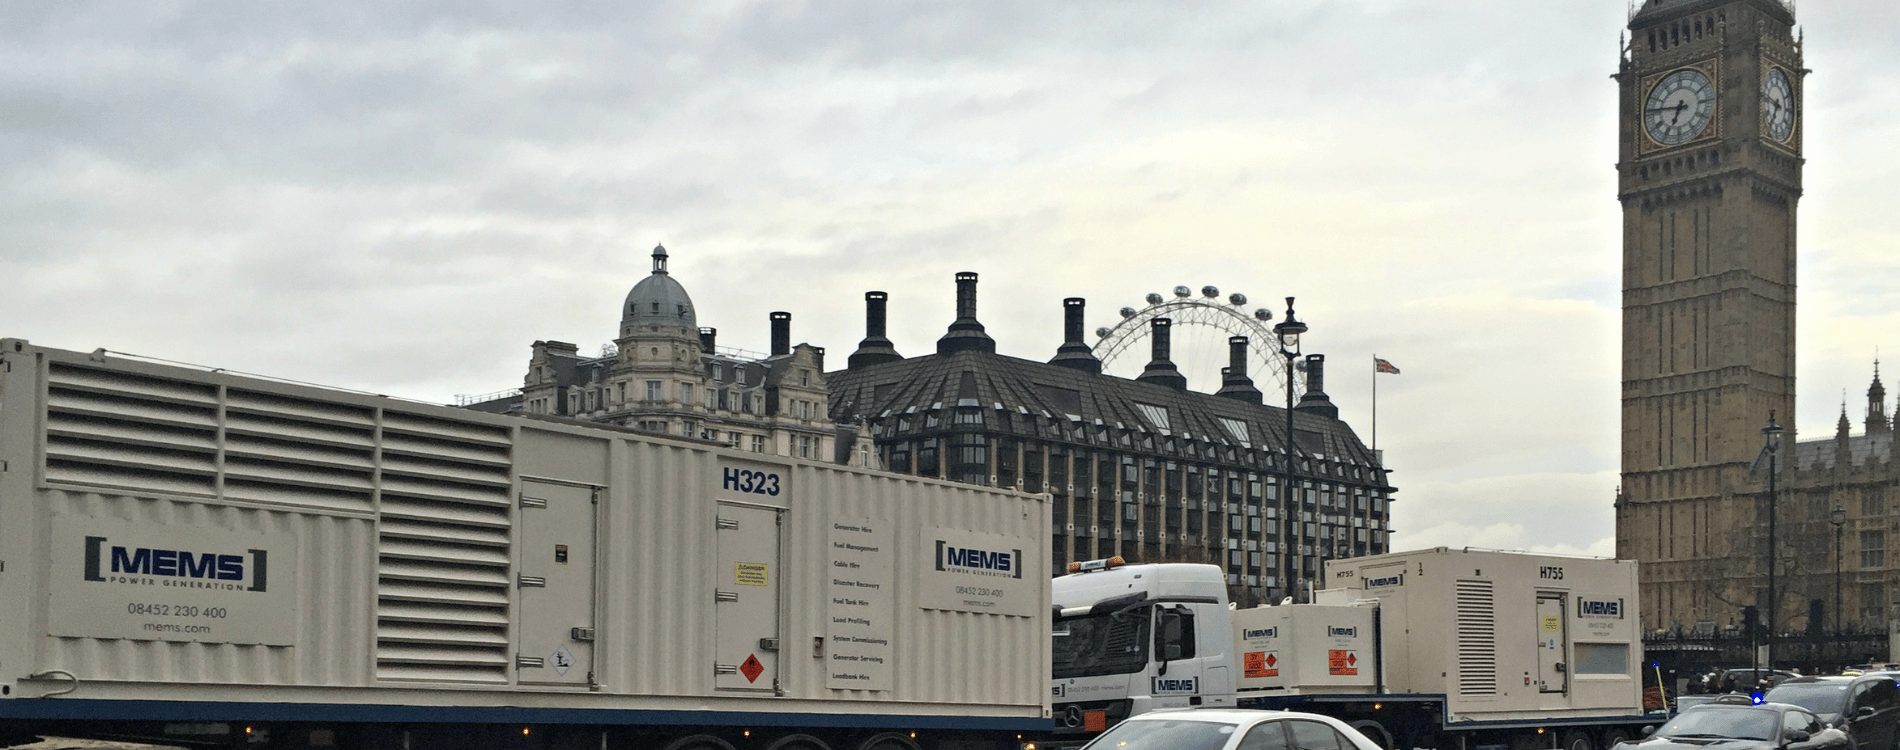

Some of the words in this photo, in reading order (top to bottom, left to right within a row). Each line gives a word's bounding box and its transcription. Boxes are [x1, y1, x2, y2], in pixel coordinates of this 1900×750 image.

[723, 467, 780, 496] H323
[846, 543, 878, 552] Management
[111, 546, 244, 581] MEMS
[947, 547, 1011, 571] MEMS
[972, 570, 1011, 578] GENERATION
[1336, 570, 1354, 579] H755
[1540, 566, 1563, 580] H755
[110, 576, 155, 585] POWER
[162, 579, 244, 591] GENERATION
[856, 581, 880, 590] Recovery
[127, 602, 169, 616] 08452
[174, 605, 199, 618] 230
[202, 607, 227, 619] 400
[1583, 601, 1618, 615] MEMS
[143, 622, 211, 634] mems.com
[1247, 628, 1273, 637] MEMS
[1331, 627, 1353, 636] MEMS
[833, 653, 858, 661] Generator
[1158, 680, 1193, 691] MEMS
